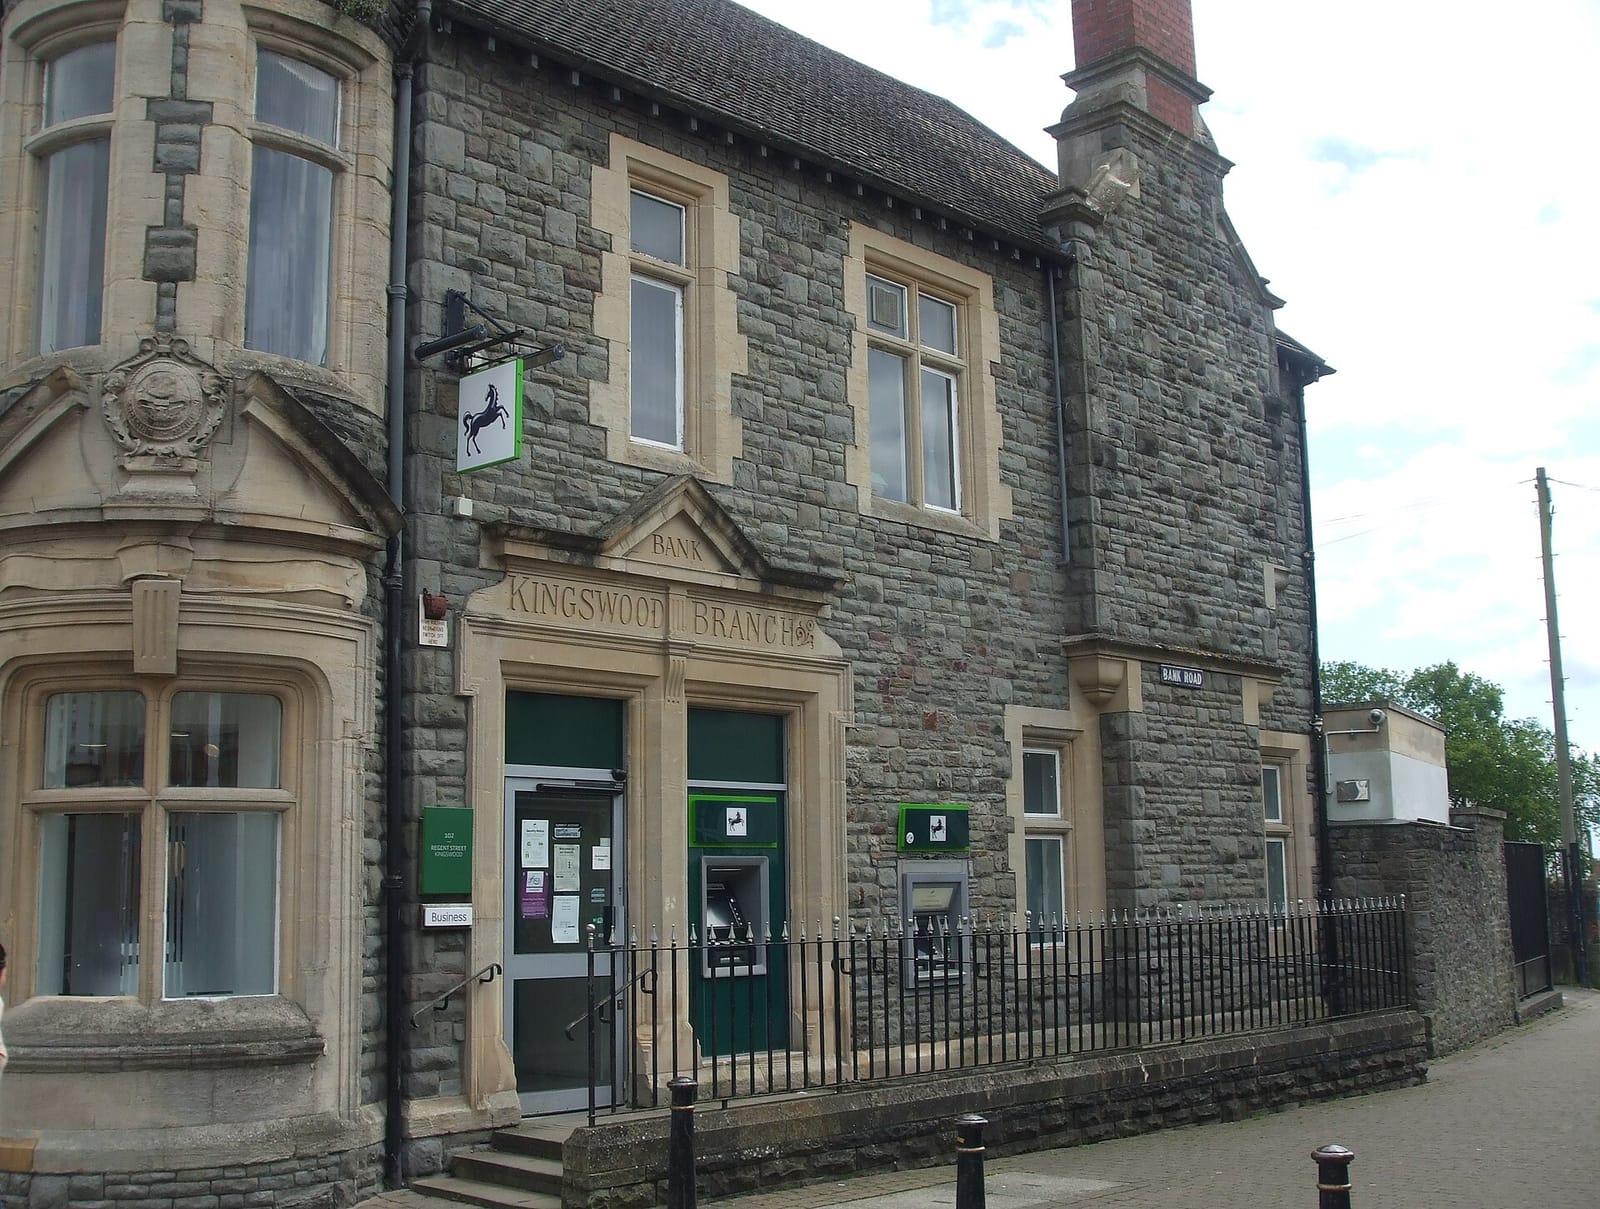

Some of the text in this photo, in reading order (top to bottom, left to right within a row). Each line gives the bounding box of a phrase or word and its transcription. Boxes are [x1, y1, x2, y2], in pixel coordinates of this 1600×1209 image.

[652, 533, 704, 562] BANK
[507, 574, 795, 647] KINGSWOOD BRANCH
[1162, 668, 1202, 685] BANK ROAD
[450, 844, 467, 852] STREET
[431, 912, 468, 923] Business
